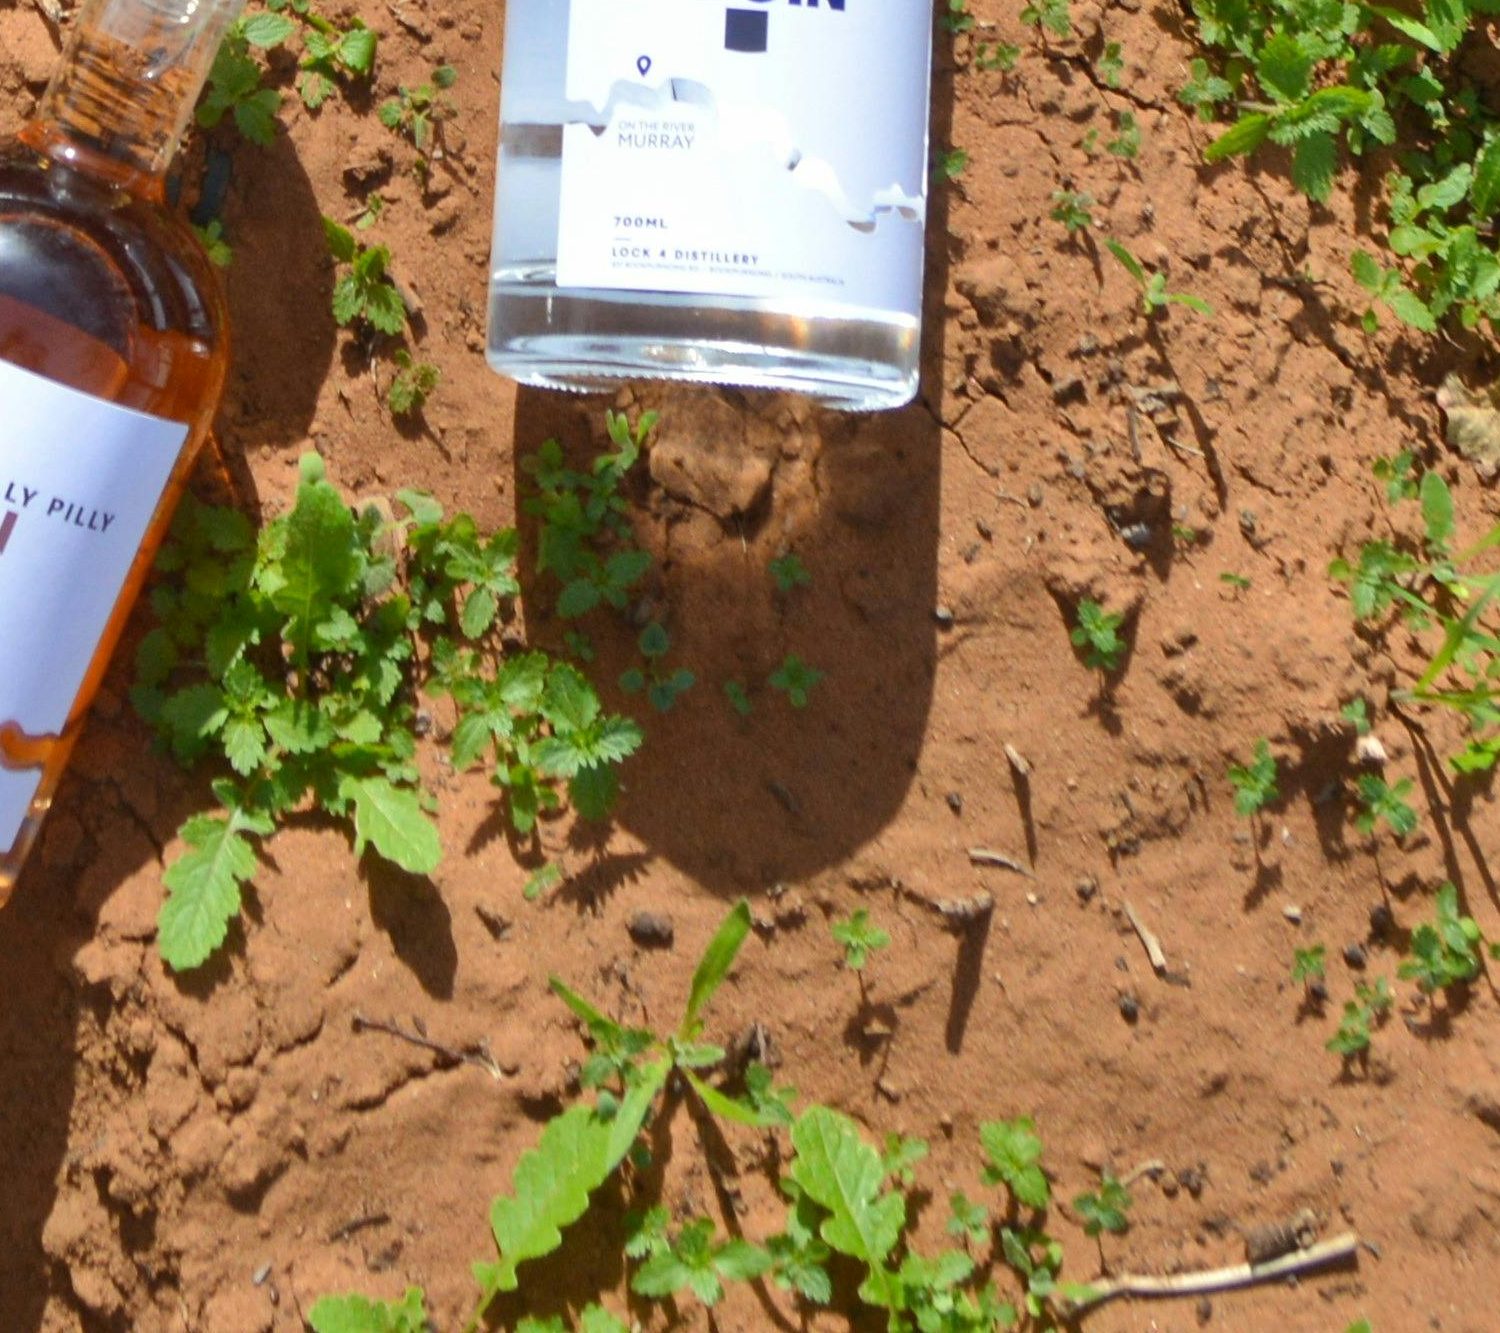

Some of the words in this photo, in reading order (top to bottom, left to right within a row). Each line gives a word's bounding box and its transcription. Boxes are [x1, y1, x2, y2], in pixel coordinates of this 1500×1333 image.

[617, 130, 695, 152] MURRAY
[613, 215, 668, 230] 700ML
[611, 245, 652, 259] LOCK
[658, 248, 667, 260] 4
[674, 249, 759, 266] DISTILLERY
[46, 497, 115, 534] PILLY
